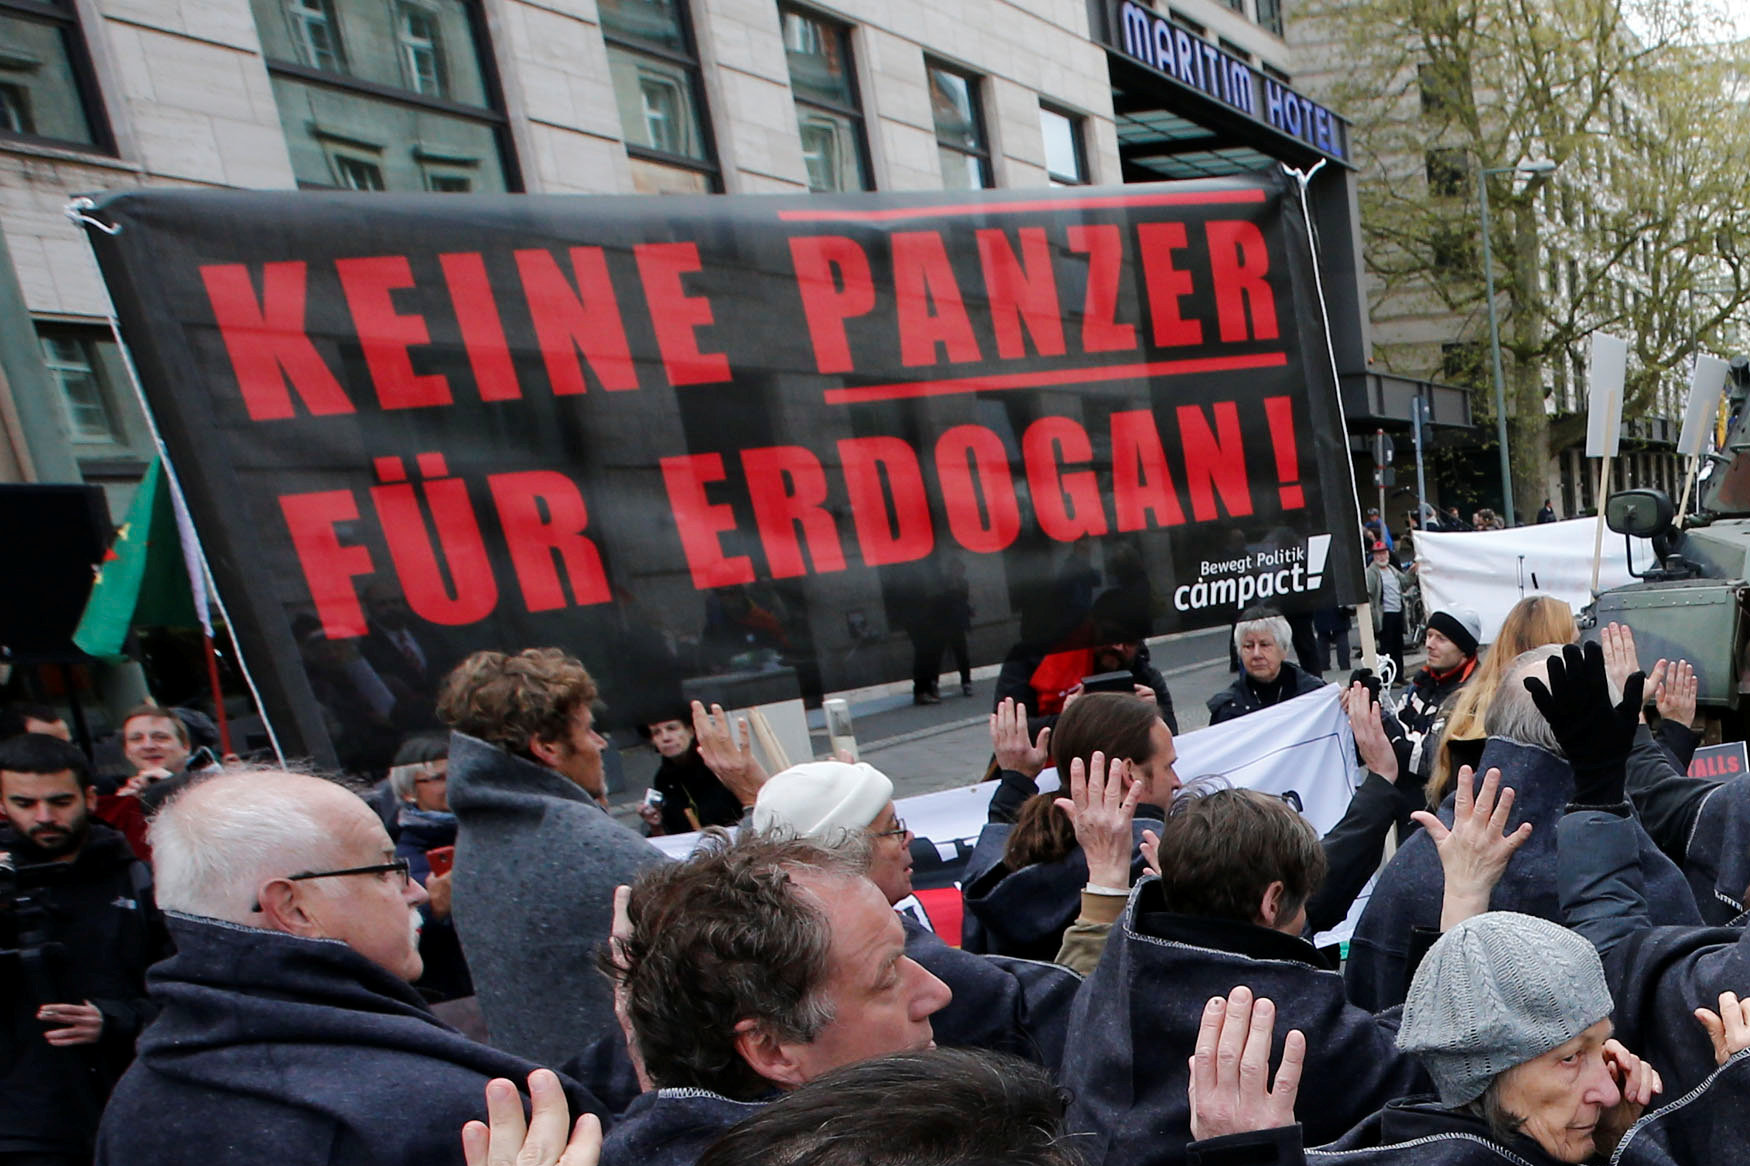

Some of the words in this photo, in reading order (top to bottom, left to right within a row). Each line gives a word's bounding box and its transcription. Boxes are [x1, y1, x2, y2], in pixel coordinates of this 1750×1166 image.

[1122, 1, 1256, 116] MARITIM
[1264, 79, 1343, 157] HOTEL
[199, 241, 733, 421] KEINE
[788, 219, 1279, 374] PANZER
[278, 452, 612, 640] FÜR
[659, 395, 1305, 590] ERDOGAN!
[1200, 556, 1252, 576] Bewegt
[1257, 546, 1304, 567] Politik
